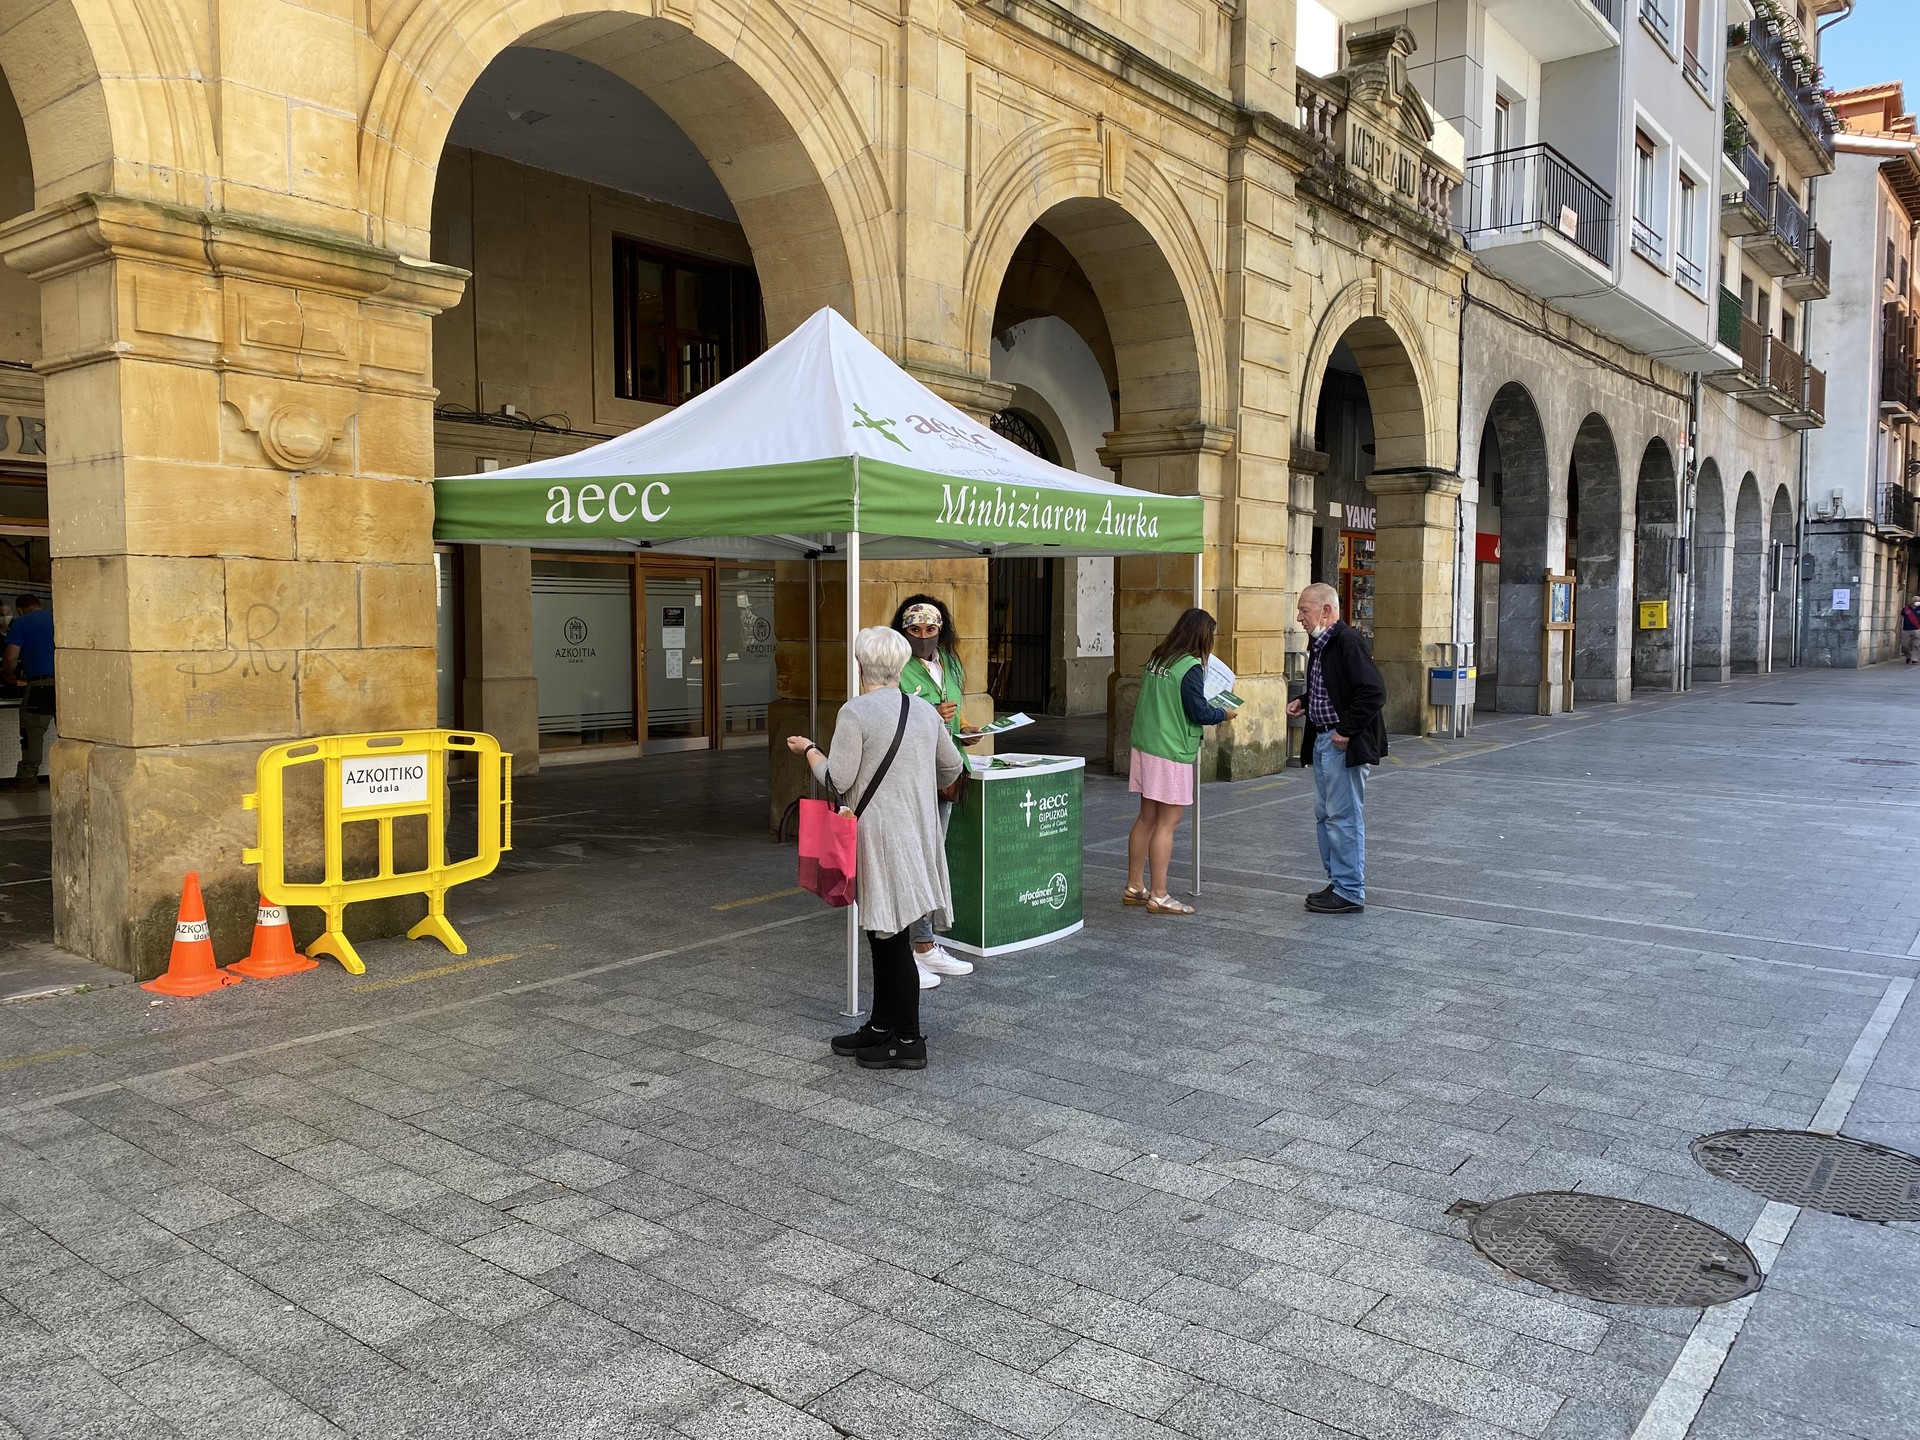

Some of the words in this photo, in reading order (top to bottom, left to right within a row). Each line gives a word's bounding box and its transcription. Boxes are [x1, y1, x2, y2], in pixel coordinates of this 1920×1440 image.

[545, 481, 671, 524] aecc
[936, 483, 1087, 532] Minbiziaren
[1094, 499, 1159, 538] Aurka
[555, 648, 596, 658] AZKOITIA
[346, 765, 423, 784] AZKOITIKO
[369, 784, 399, 793] Udala
[1039, 792, 1069, 811] aecc
[1038, 808, 1069, 822] GIPUZKOA
